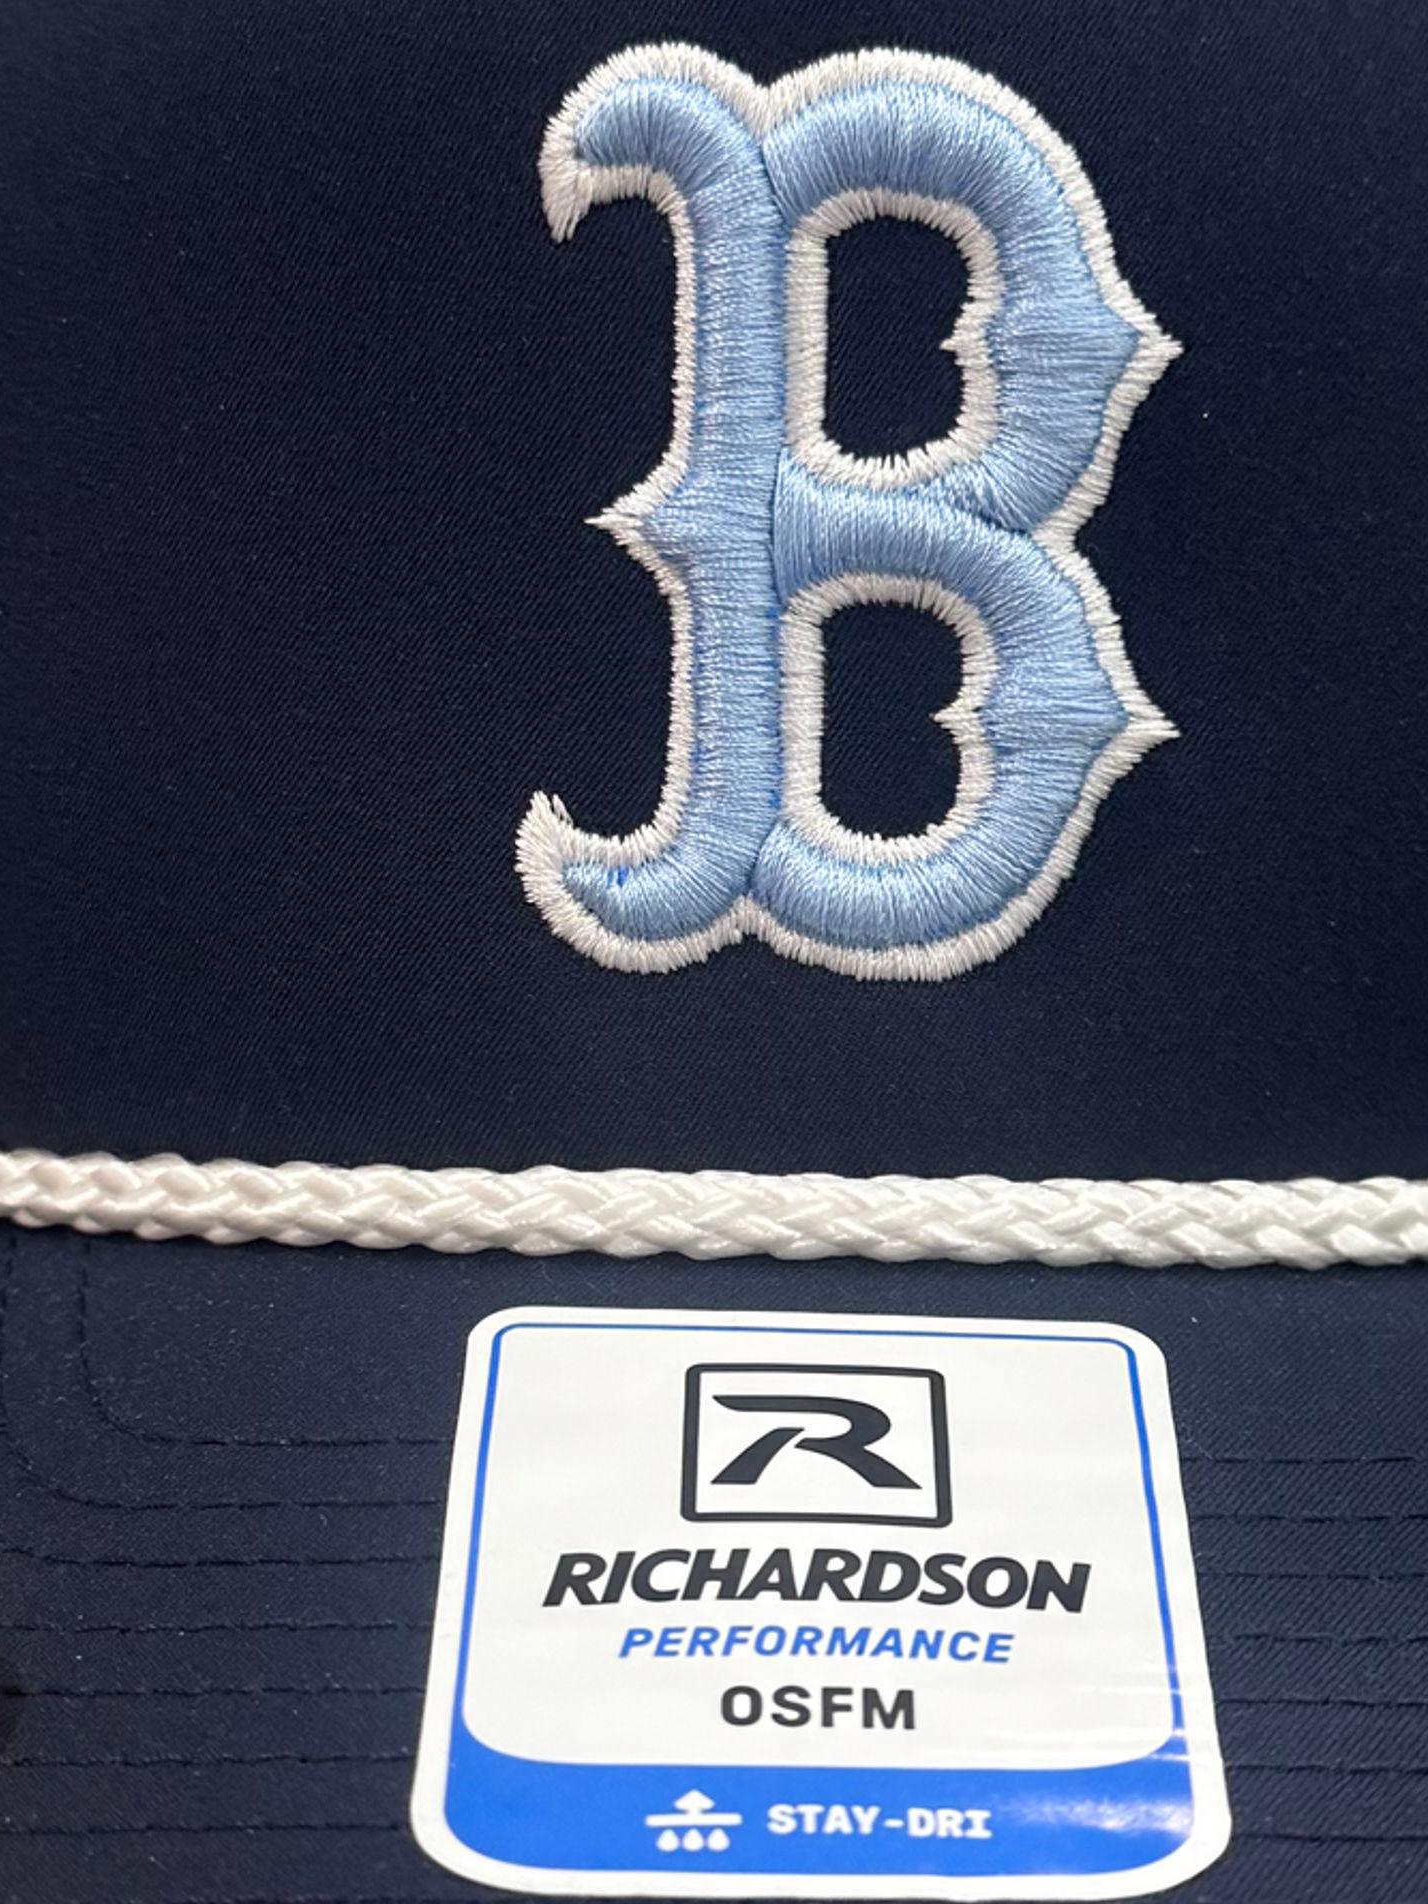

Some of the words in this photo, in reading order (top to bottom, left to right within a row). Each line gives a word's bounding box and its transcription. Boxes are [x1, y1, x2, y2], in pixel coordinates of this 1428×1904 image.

[515, 41, 1184, 982] B
[711, 1394, 923, 1491] R
[541, 1547, 1092, 1614] RICHARDSON
[617, 1624, 1015, 1663] PERFORMANCE
[719, 1684, 916, 1730] OSFM
[766, 1803, 993, 1840] STAY-DRI
